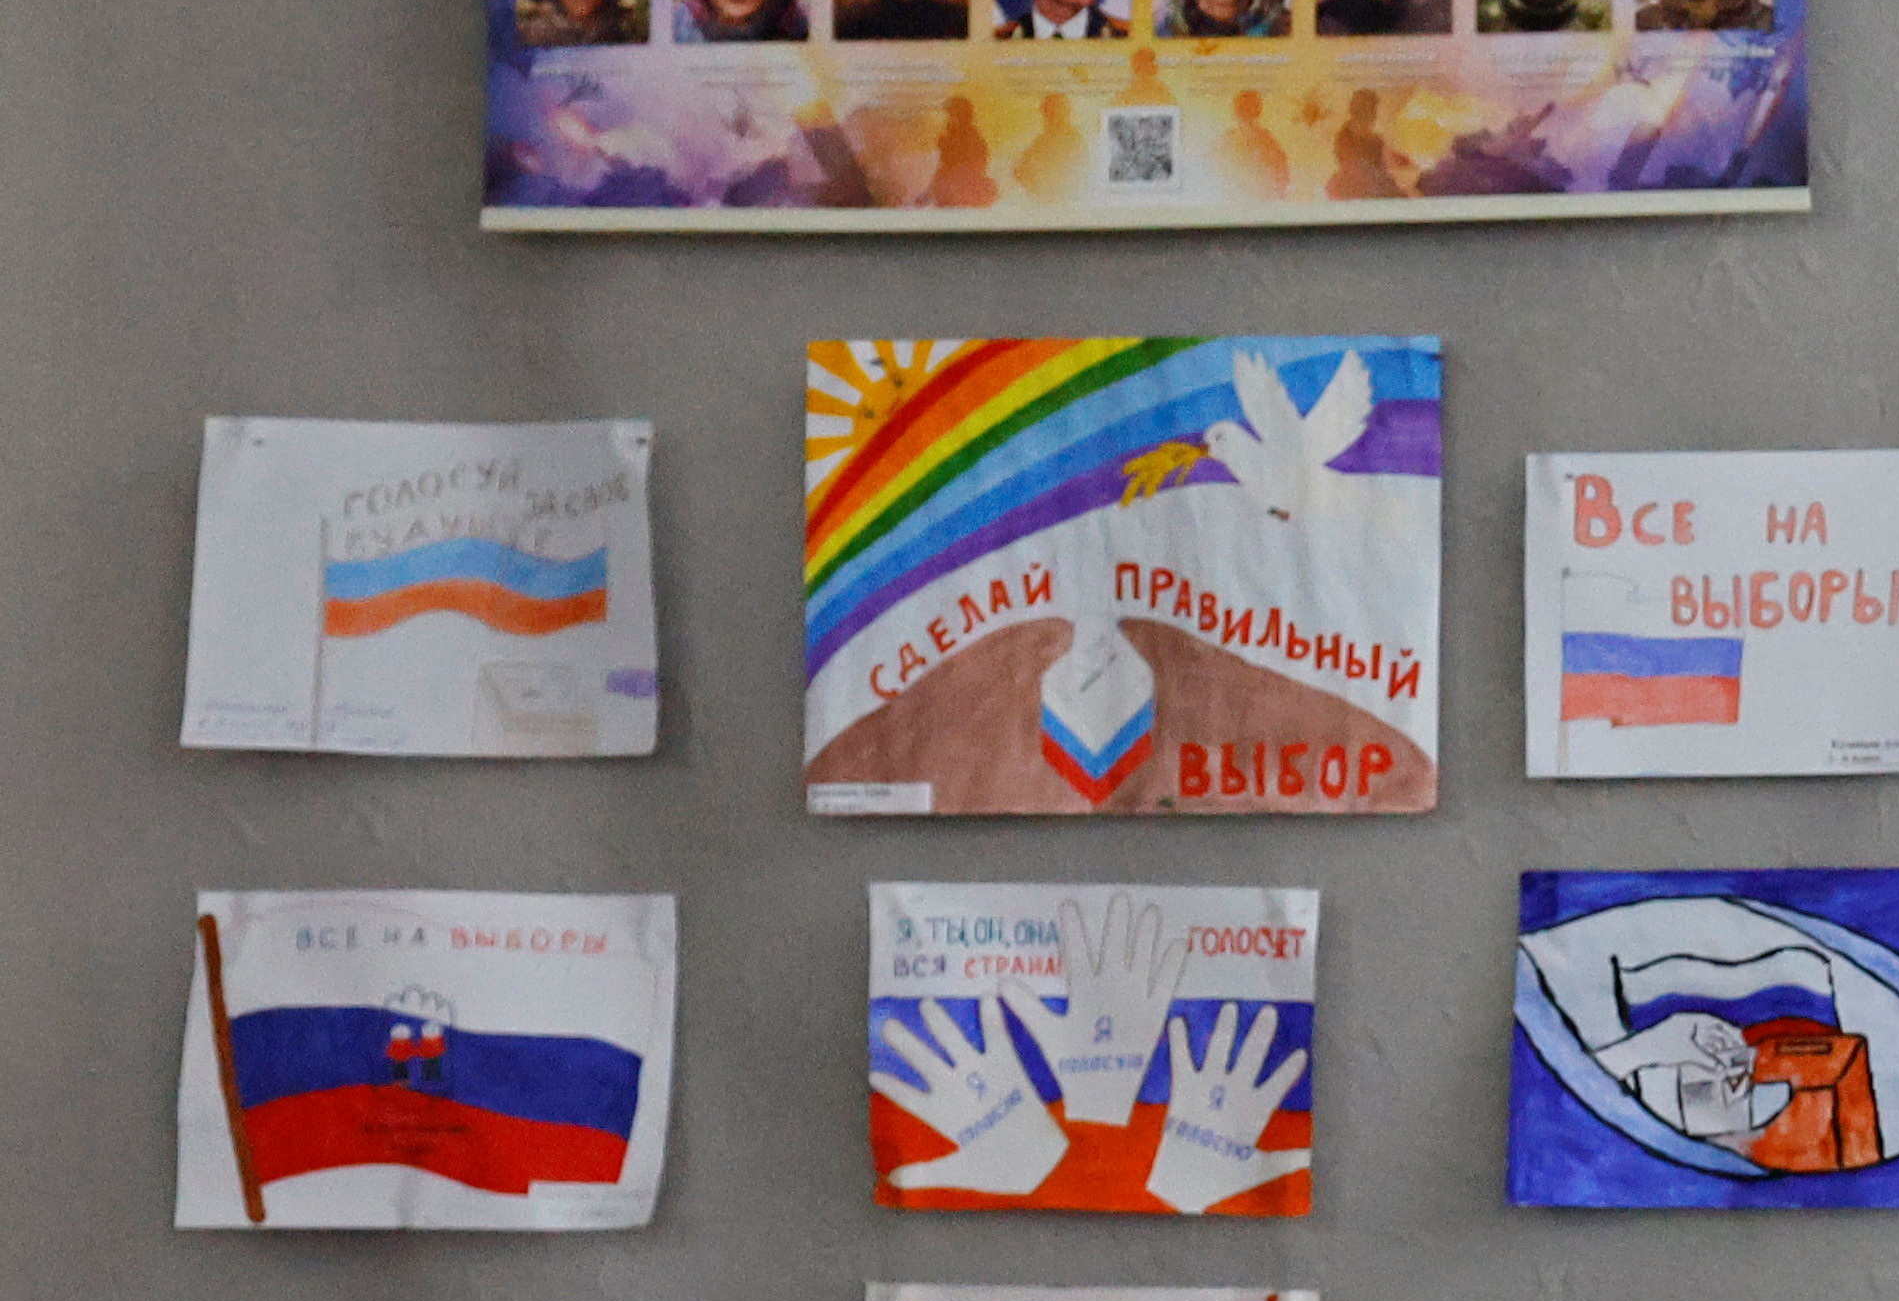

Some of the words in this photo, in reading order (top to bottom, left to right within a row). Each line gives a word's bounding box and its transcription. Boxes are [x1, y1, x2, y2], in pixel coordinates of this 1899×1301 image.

[869, 562, 1054, 700] СДЕЛАЙ
[1115, 562, 1423, 700] ПРАВИЛЬНЫЙ
[1177, 741, 1396, 800] ВЫБОР
